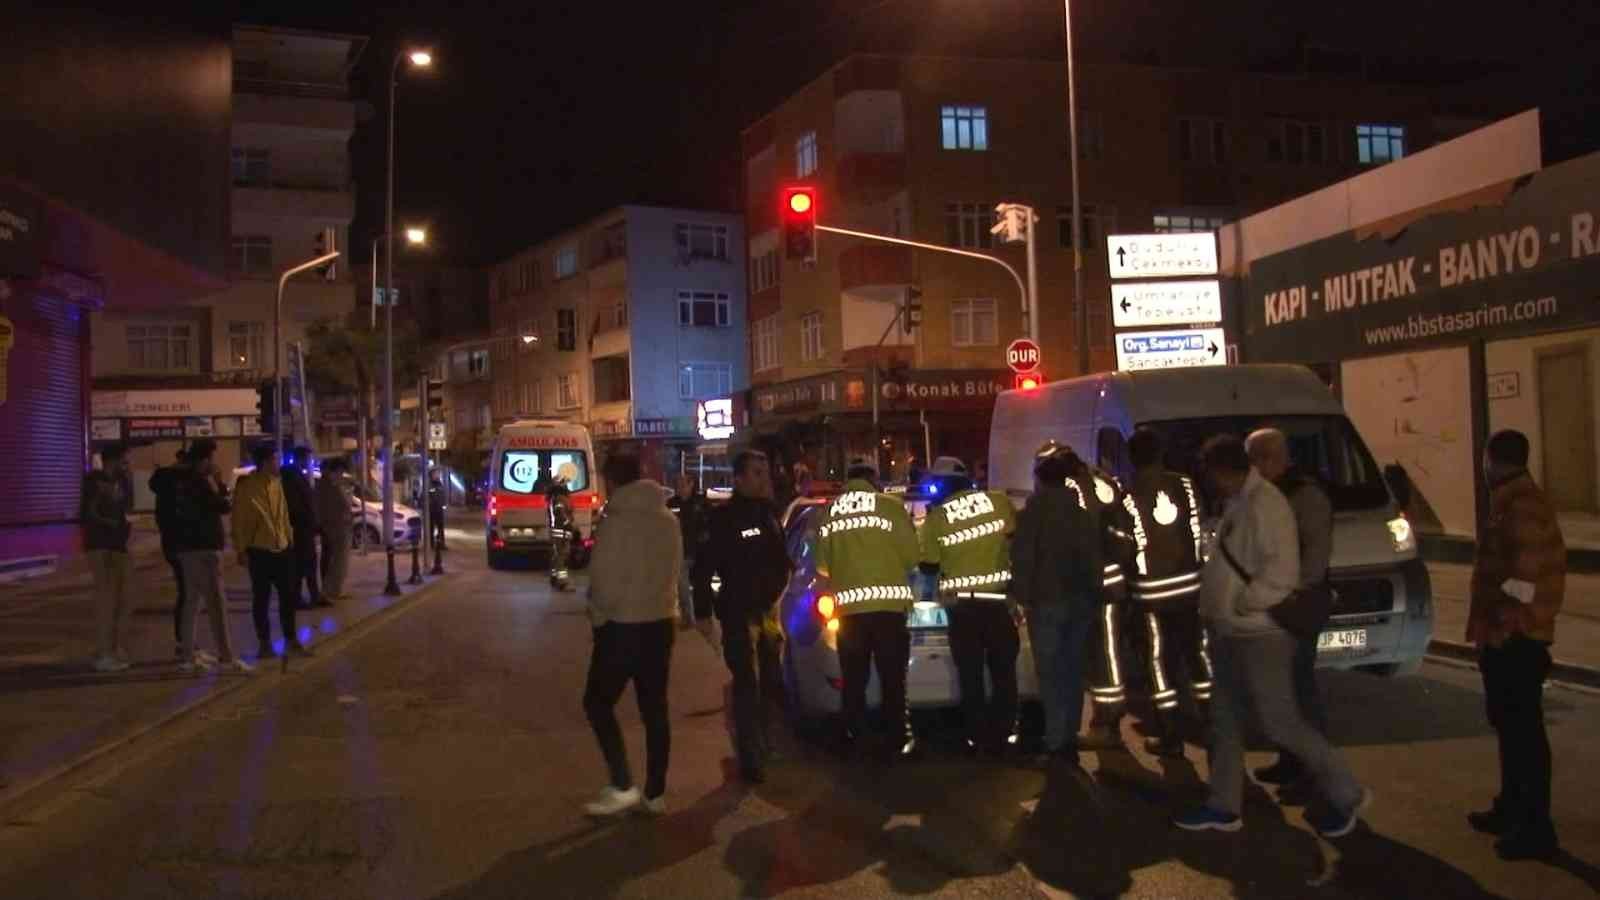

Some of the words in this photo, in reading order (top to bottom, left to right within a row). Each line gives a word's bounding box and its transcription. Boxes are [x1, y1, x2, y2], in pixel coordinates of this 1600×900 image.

[1263, 284, 1309, 326] KAPI
[1323, 257, 1416, 313] MUTFAK
[1439, 225, 1541, 289] BANYO
[1365, 295, 1557, 345] www.bbstasarim.com
[1009, 349, 1038, 364] DUR
[906, 382, 961, 398] Konak
[509, 436, 578, 447] AMBULANS
